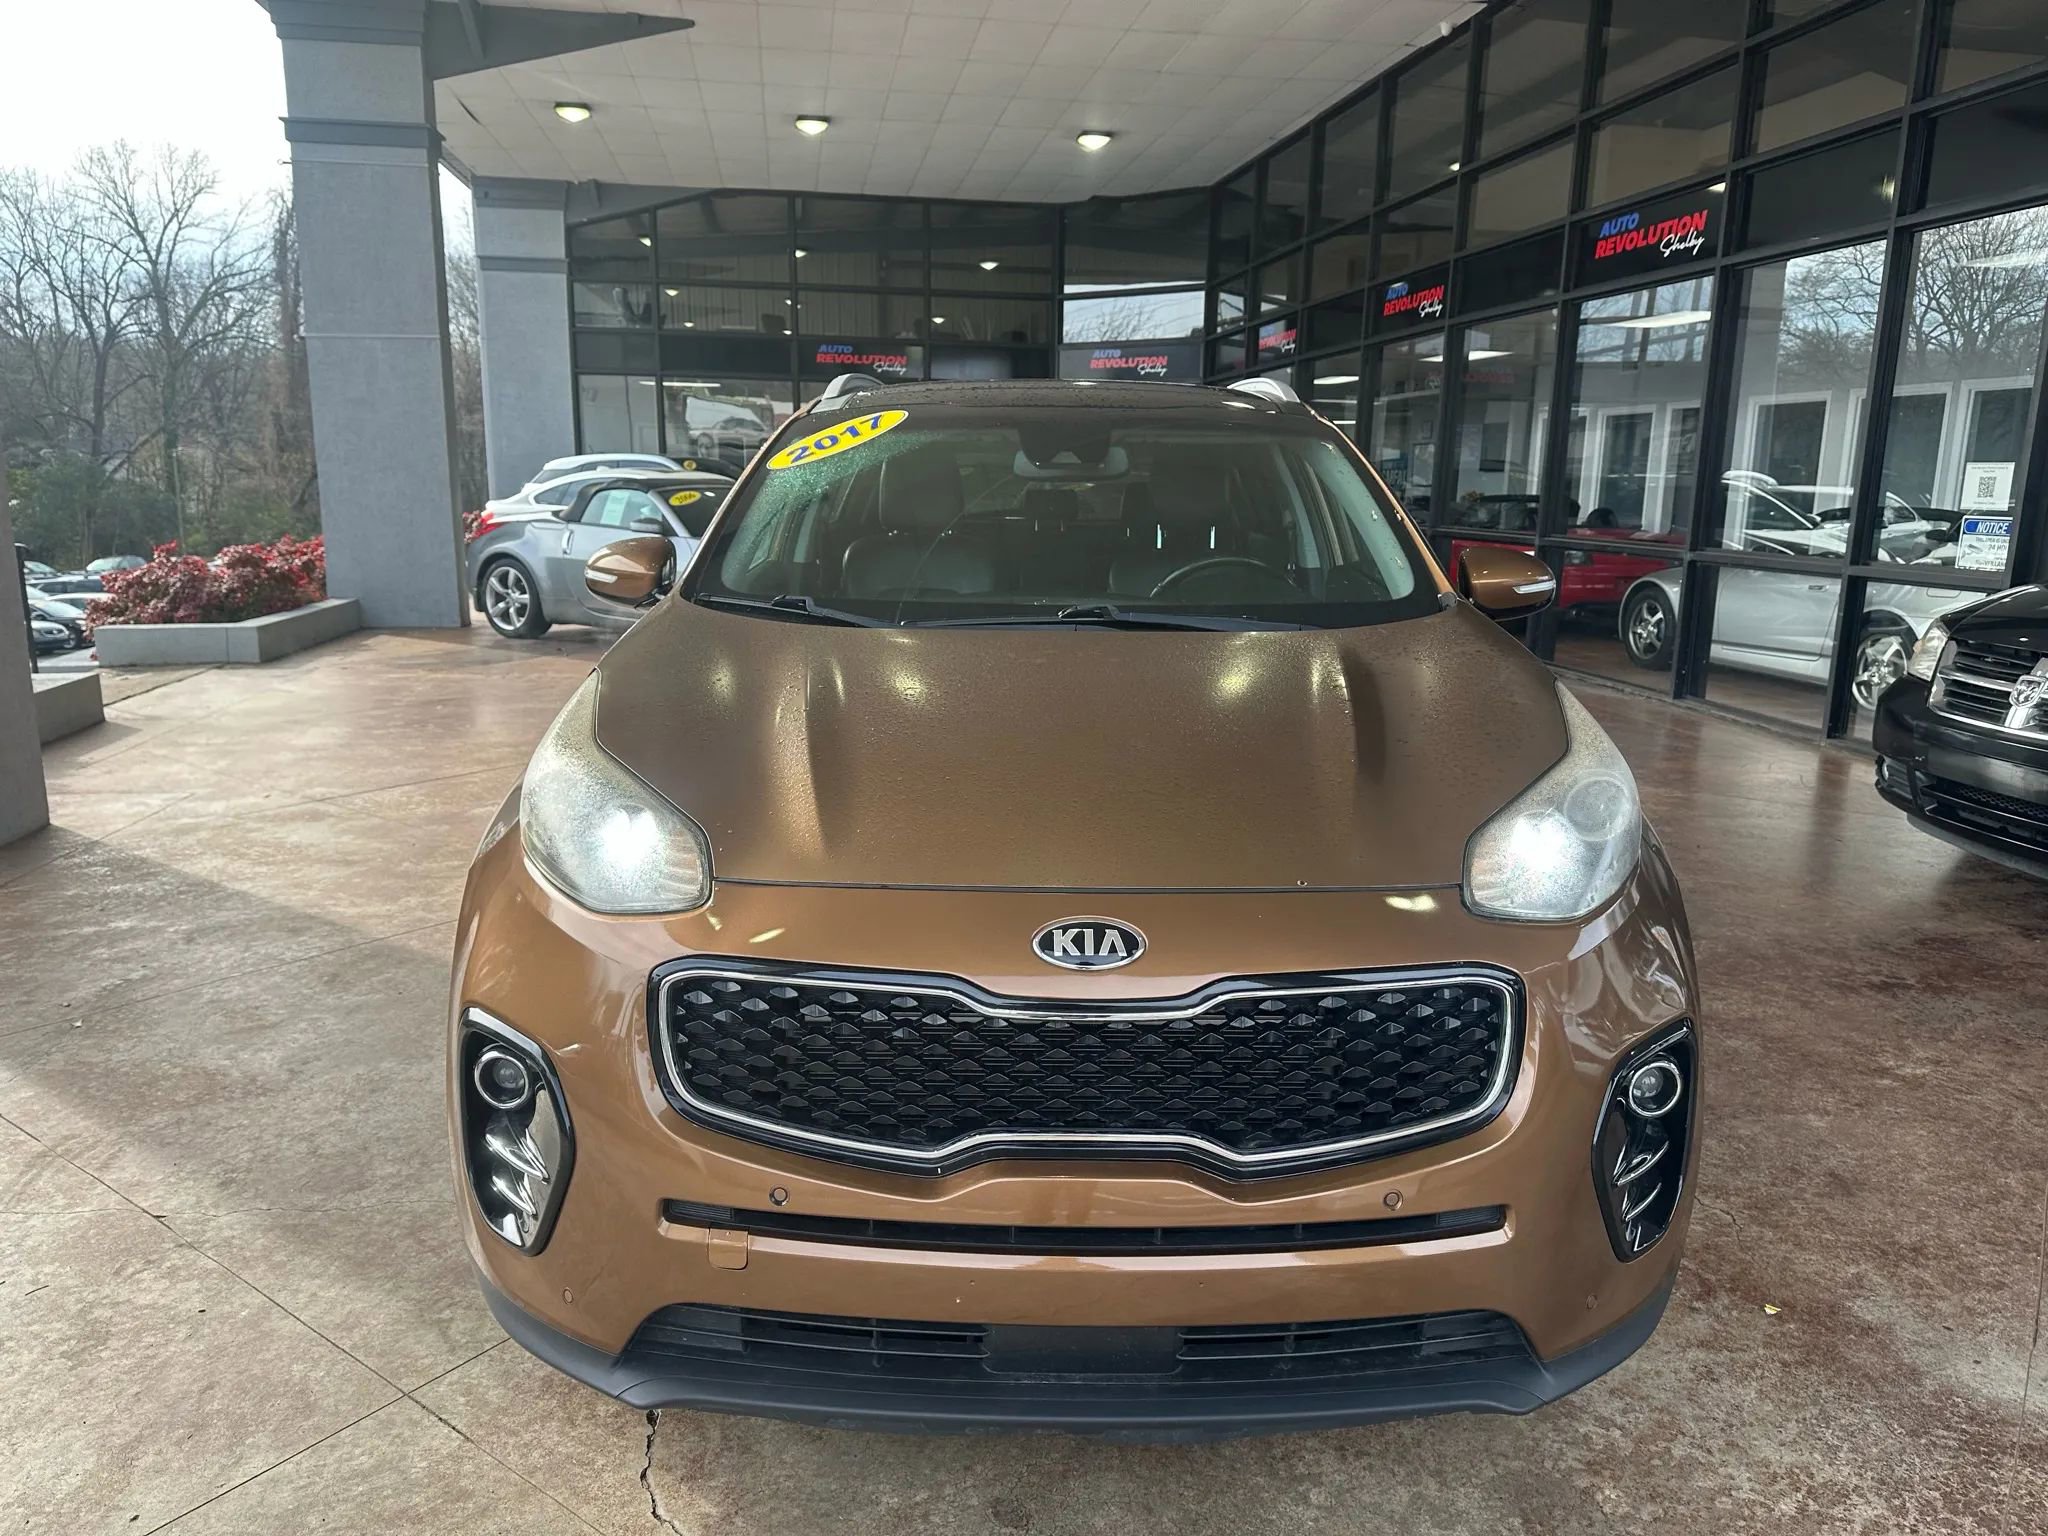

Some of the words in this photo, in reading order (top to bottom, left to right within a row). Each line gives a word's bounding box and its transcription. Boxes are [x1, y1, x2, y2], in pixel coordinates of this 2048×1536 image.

[1595, 209, 1708, 259] REVOLUTION
[1599, 212, 1640, 238] AUTO
[1660, 227, 1705, 258] Shelby
[1383, 284, 1445, 316] REVOLUTION
[1386, 283, 1409, 300] AUTO
[816, 353, 907, 365] REVOLUTION
[818, 344, 854, 353] AUTO
[1092, 349, 1122, 358] AUTO
[1090, 356, 1168, 369] REVOLUTION
[786, 414, 883, 464] 2017
[1976, 521, 2010, 534] NOTICE
[1051, 927, 1128, 957] KIA
